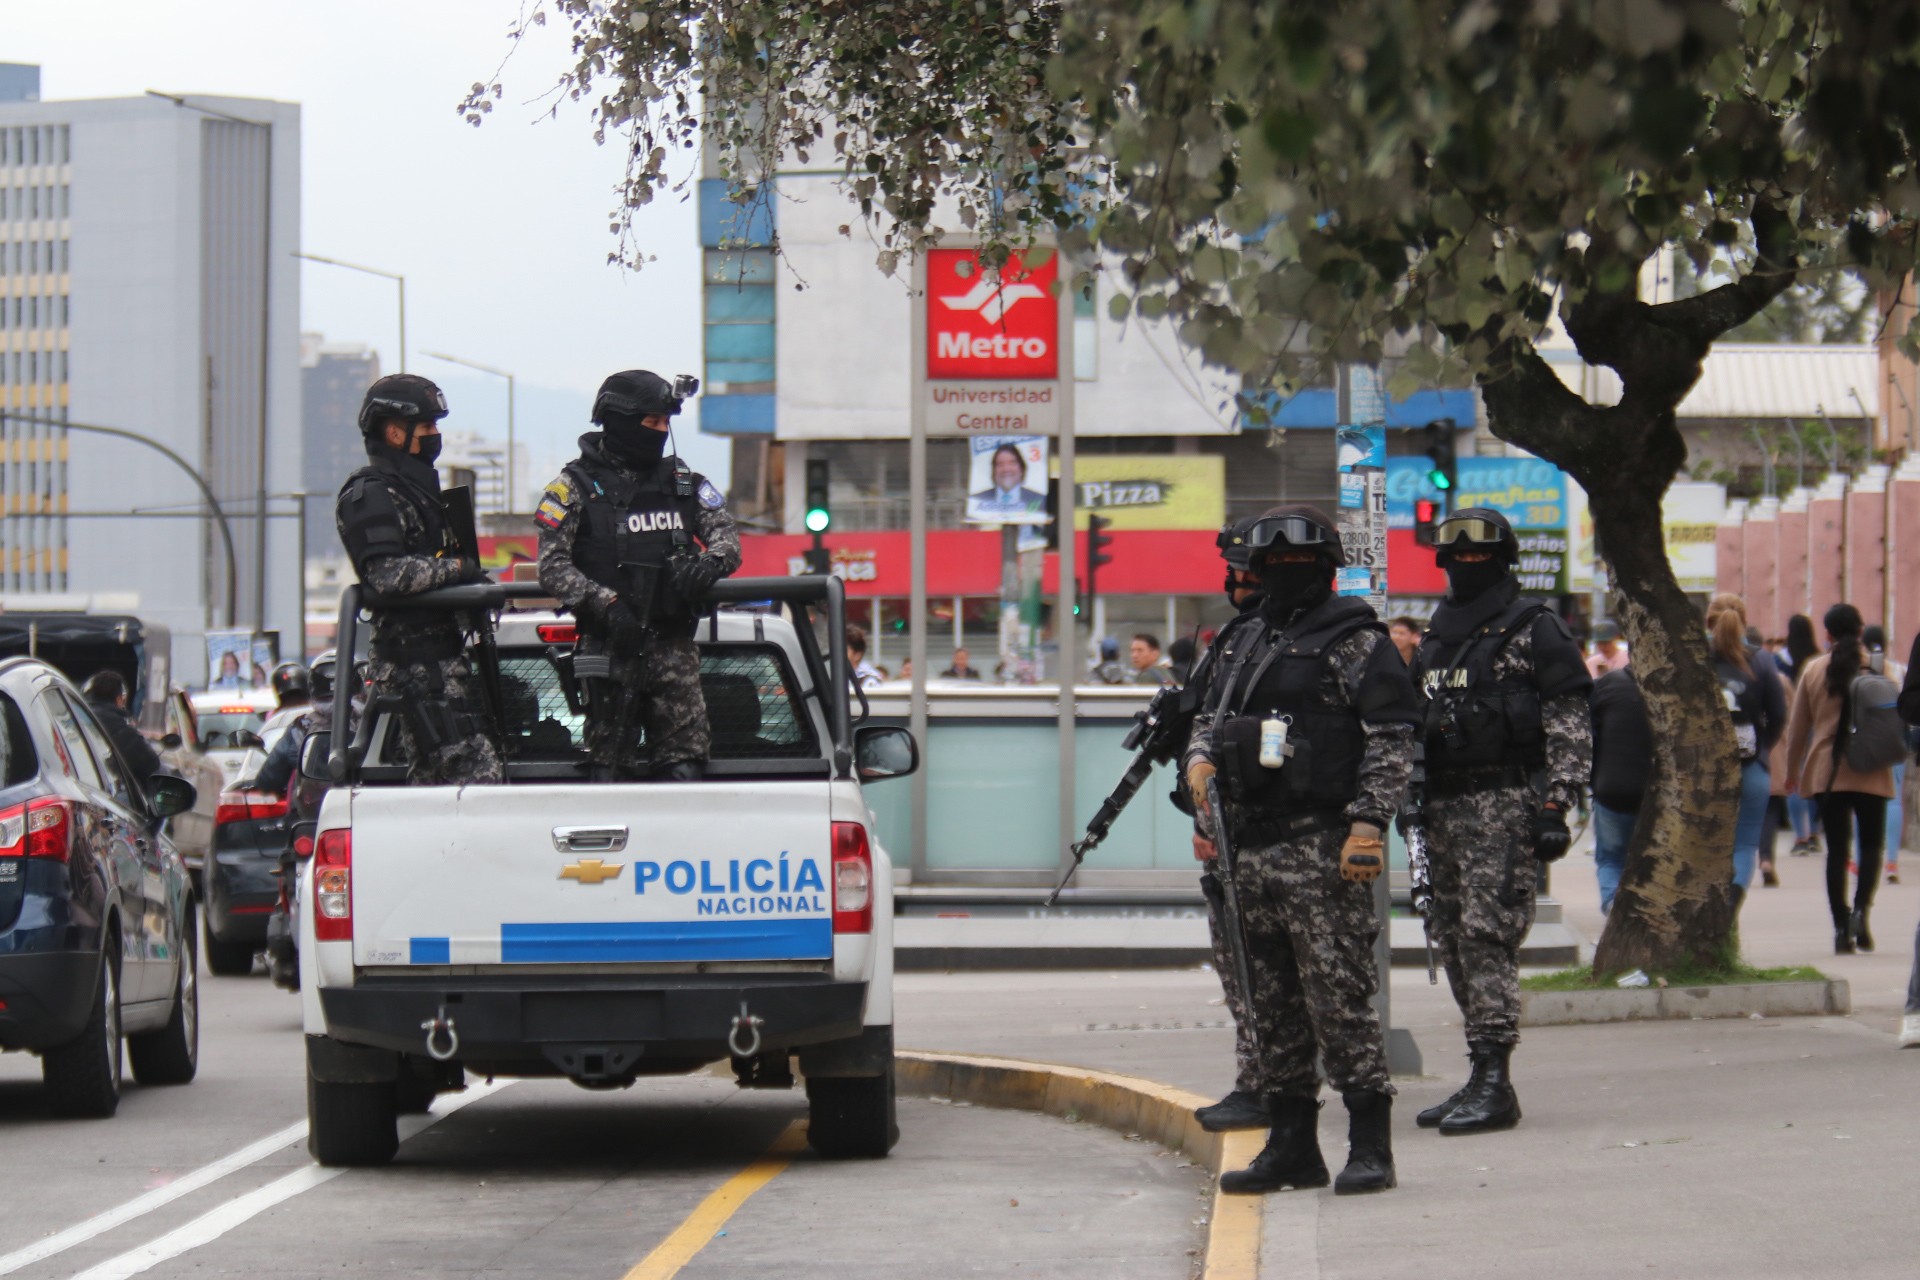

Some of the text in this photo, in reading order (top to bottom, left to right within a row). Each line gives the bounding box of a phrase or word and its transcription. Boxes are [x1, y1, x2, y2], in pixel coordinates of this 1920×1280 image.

[937, 331, 1047, 359] Metro
[932, 386, 1052, 404] Universidad
[956, 413, 1029, 430] Central
[1082, 481, 1161, 507] Pizza
[628, 511, 684, 533] OLICIA
[1526, 505, 1560, 525] 3D
[1518, 532, 1567, 553] seños
[1344, 547, 1376, 567] SIS
[634, 851, 824, 895] POLICÍA
[697, 894, 825, 916] NACIONAL
